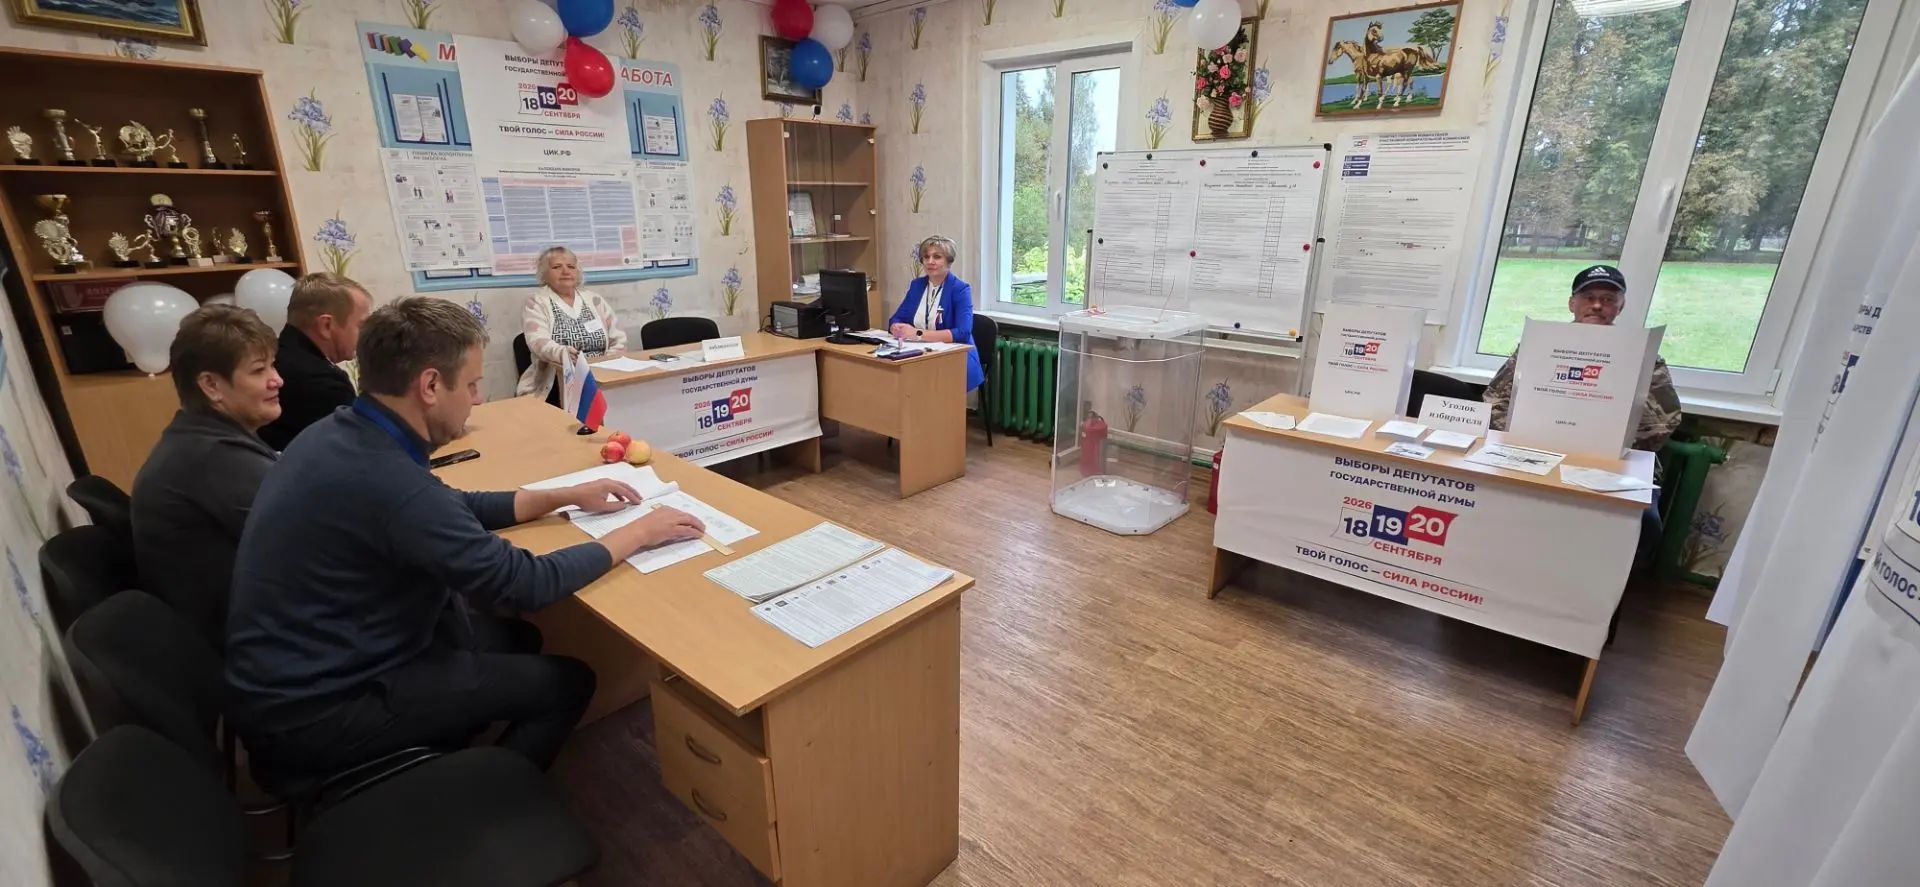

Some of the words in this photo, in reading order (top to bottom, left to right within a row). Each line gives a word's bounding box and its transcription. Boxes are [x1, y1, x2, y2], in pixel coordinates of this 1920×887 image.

[505, 54, 538, 65] ВЫБОРЫ
[522, 97, 539, 110] 18
[540, 92, 556, 105] 19
[557, 87, 576, 101] 20
[544, 110, 581, 119] СЕНТЯБРЯ
[499, 125, 520, 133] ТВОЙ
[521, 127, 547, 135] ГОЛОС
[1365, 344, 1378, 352] 20
[683, 372, 715, 384] ВЫБОРЫ
[716, 365, 756, 378] ДЕПУТАТОВ
[1556, 372, 1567, 381] 18
[1570, 370, 1582, 378] 19
[1584, 367, 1599, 376] 20
[681, 378, 740, 395] ГОСУДАРСТВЕННОЙ
[740, 376, 757, 384] ДУМЫ
[697, 415, 713, 430] 18
[714, 404, 730, 419] 19
[731, 394, 749, 409] 20
[1441, 400, 1476, 412] Уголок
[717, 417, 752, 431] СЕНТЯБРЯ
[1429, 412, 1482, 426] избирателя
[695, 444, 719, 455] ГОЛОС
[726, 439, 745, 447] СИЛА
[745, 430, 774, 442] РОССИИ!
[1334, 456, 1390, 474] ВЫБОРЫ
[1393, 468, 1476, 492] ДЕПУТАТОВ
[1330, 470, 1436, 499] ГОСУДАРСТВЕННОЙ
[1438, 493, 1476, 508] ДУМЫ
[1343, 496, 1372, 510] 2026
[1343, 517, 1368, 537] 18
[1376, 515, 1402, 536] 19
[1408, 513, 1445, 537] 20
[1374, 541, 1442, 566] СЕНТЯБРЯ
[1296, 545, 1326, 561] ТВОЙ
[1328, 555, 1369, 573] ГОЛОС
[1382, 569, 1418, 587] СИЛА
[1421, 581, 1484, 605] РОССИИ!
[1880, 561, 1918, 599] ГОЛОС
